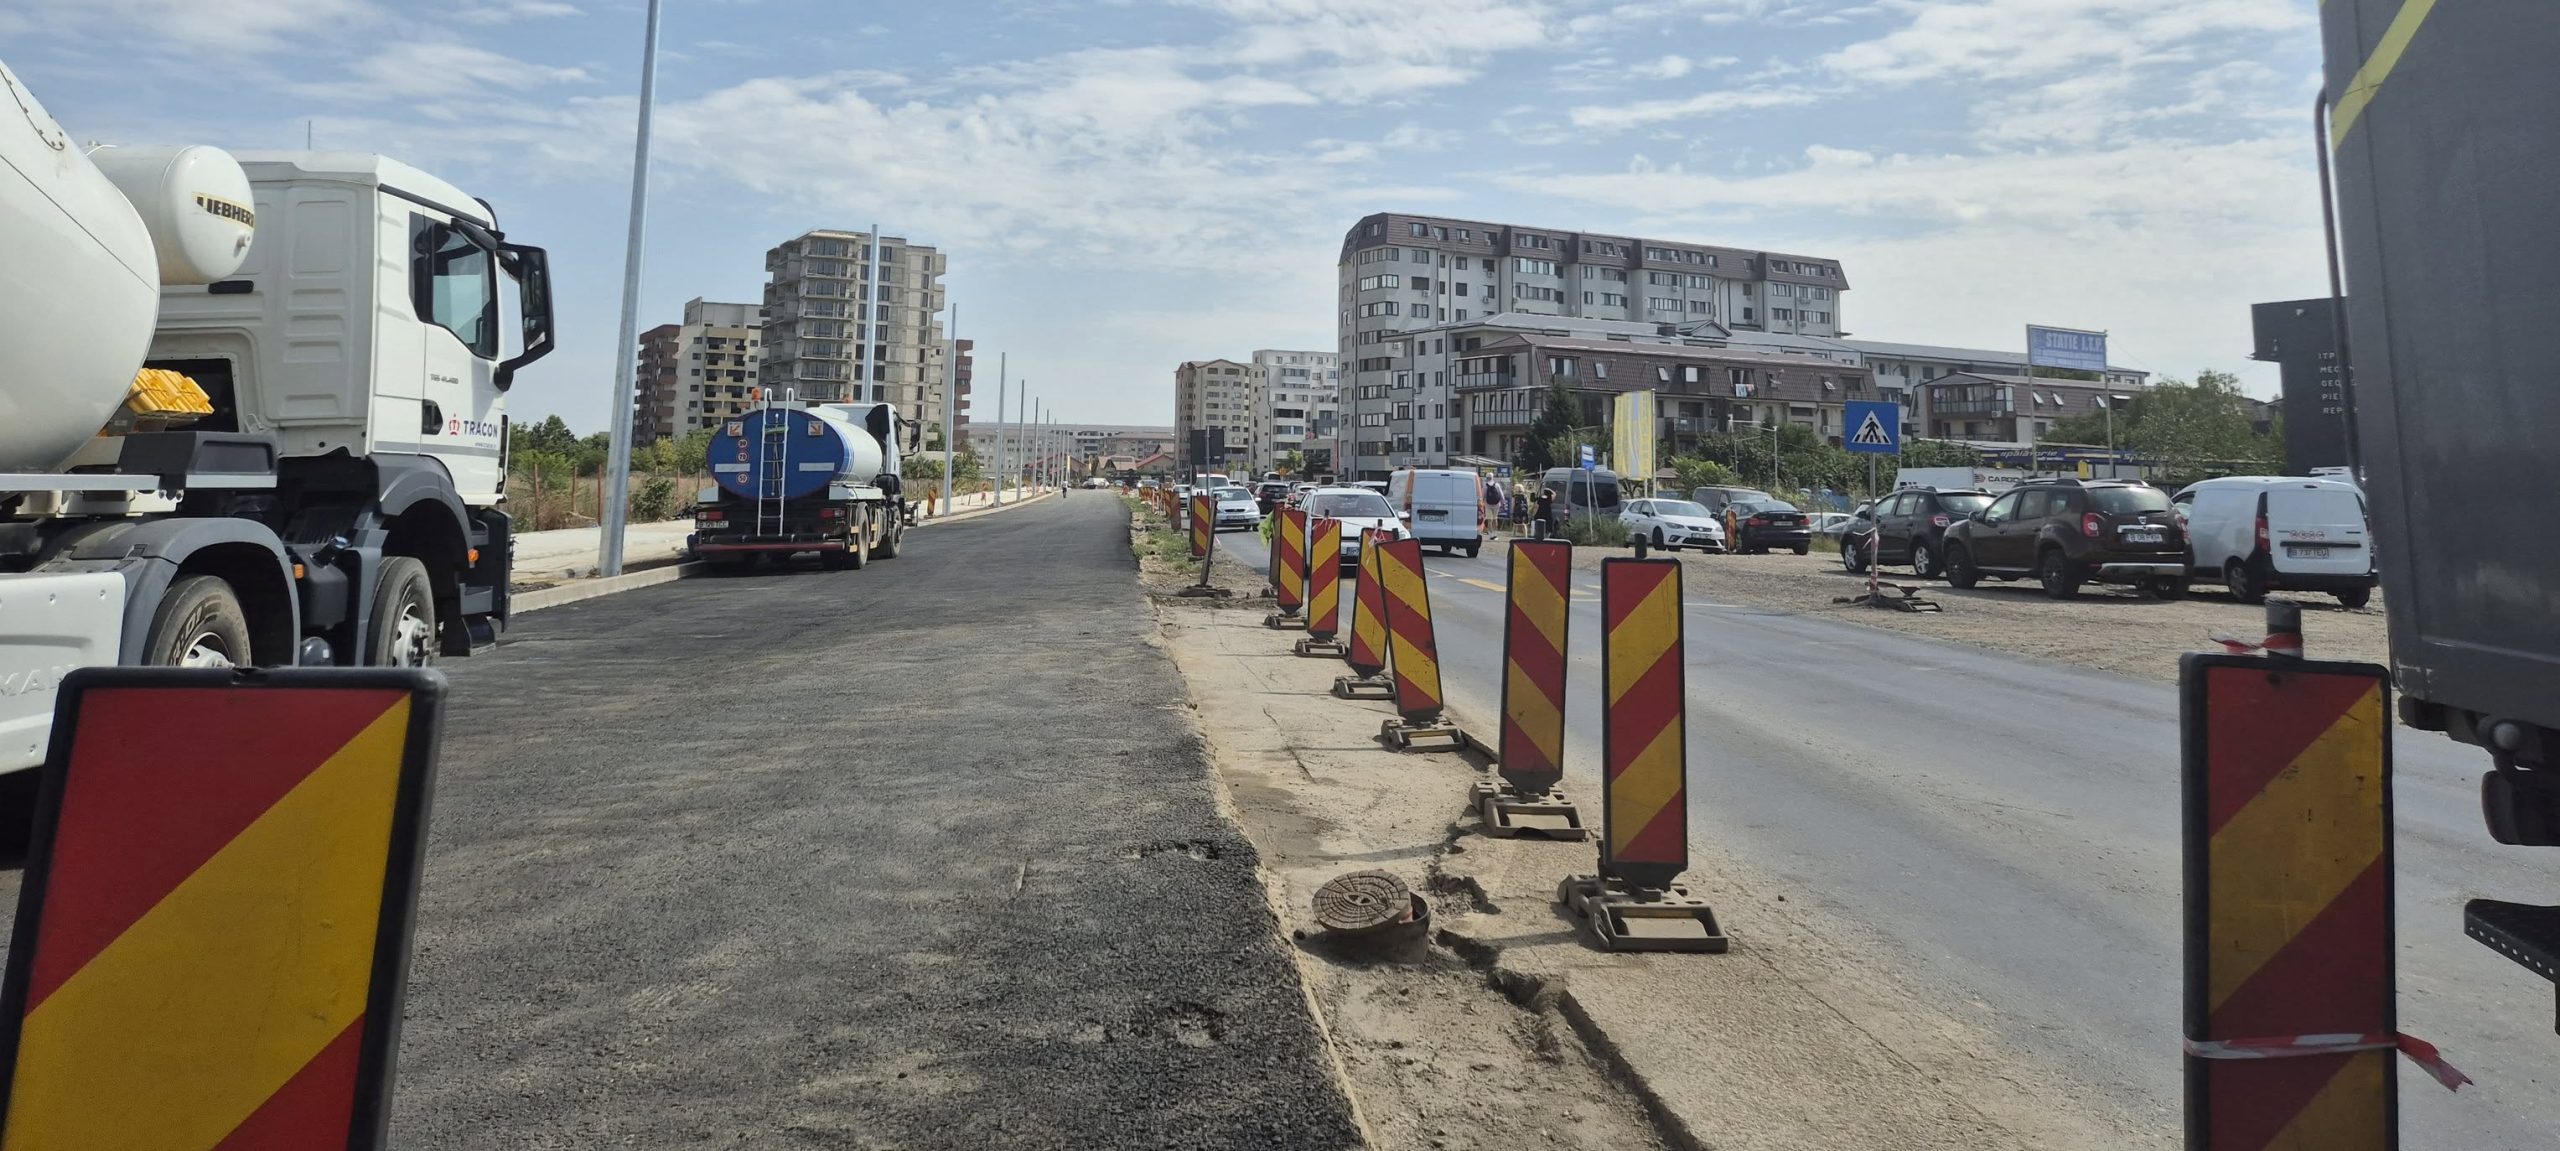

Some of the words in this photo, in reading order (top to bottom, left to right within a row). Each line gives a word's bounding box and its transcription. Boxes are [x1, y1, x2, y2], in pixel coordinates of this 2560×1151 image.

[2046, 332, 2079, 350] STATIE
[2318, 352, 2335, 360] ITP
[463, 420, 498, 438] TRACON
